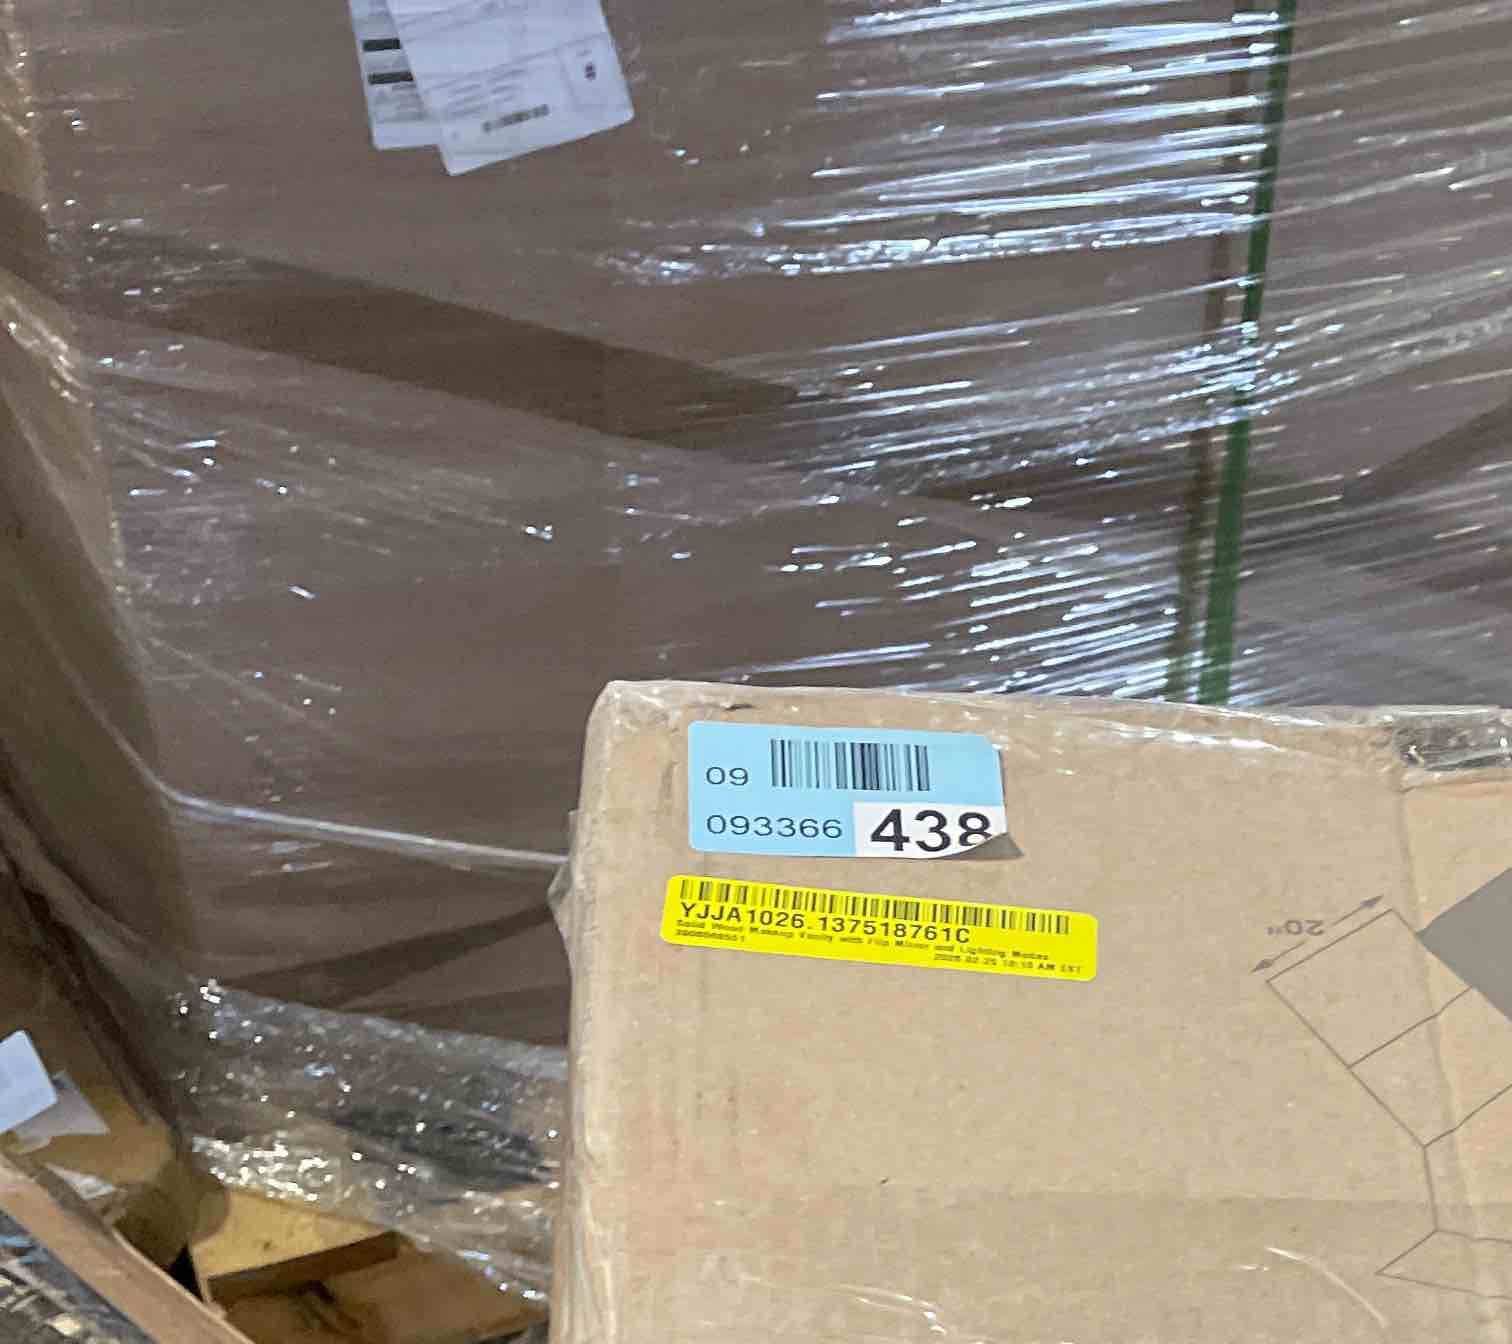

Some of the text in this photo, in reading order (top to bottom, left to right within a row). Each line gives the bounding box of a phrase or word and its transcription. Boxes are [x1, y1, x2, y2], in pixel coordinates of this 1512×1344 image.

[705, 766, 749, 786] 09
[705, 808, 991, 853] 093366 438
[1265, 919, 1325, 937] 20"
